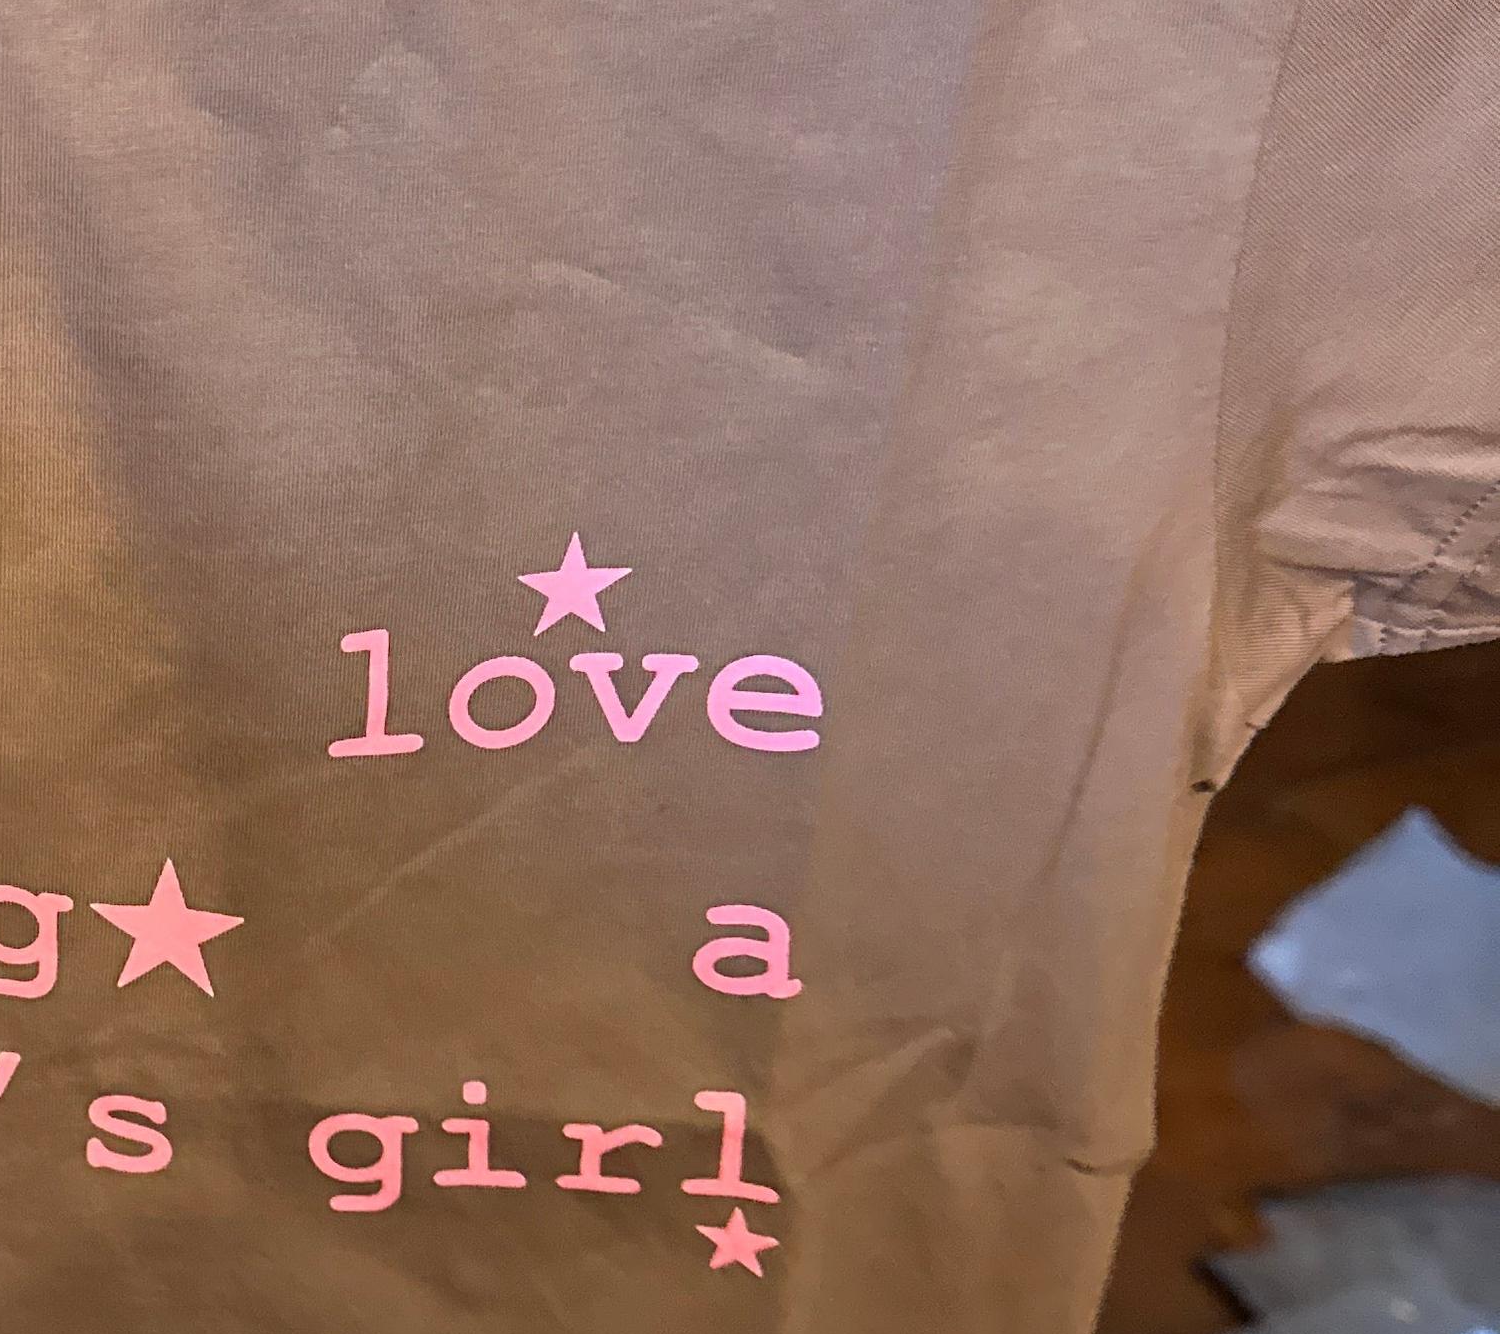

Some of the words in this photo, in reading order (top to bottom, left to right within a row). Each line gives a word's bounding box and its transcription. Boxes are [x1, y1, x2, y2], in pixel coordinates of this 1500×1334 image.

[328, 628, 824, 759] love
[691, 903, 804, 1000] a
[307, 1079, 781, 1214] girl
